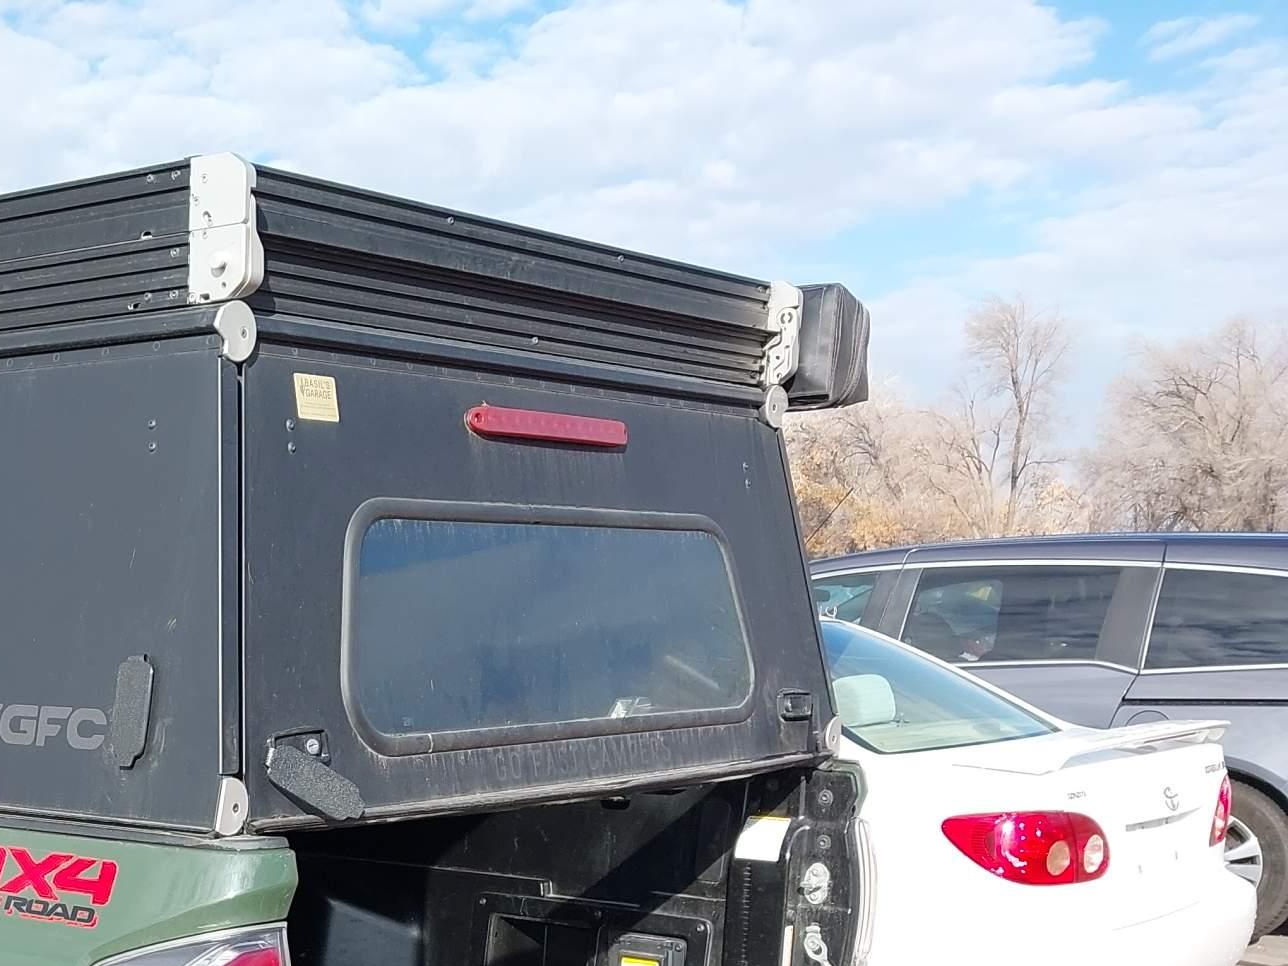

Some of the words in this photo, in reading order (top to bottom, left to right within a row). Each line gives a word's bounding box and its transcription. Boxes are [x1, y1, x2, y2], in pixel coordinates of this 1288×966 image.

[305, 378, 331, 389] BASIL'S
[305, 388, 332, 400] GARAGE
[495, 752, 521, 780] GO
[528, 744, 581, 777] FAST
[587, 735, 672, 770] CAMPERS
[3, 894, 99, 928] ROAD
